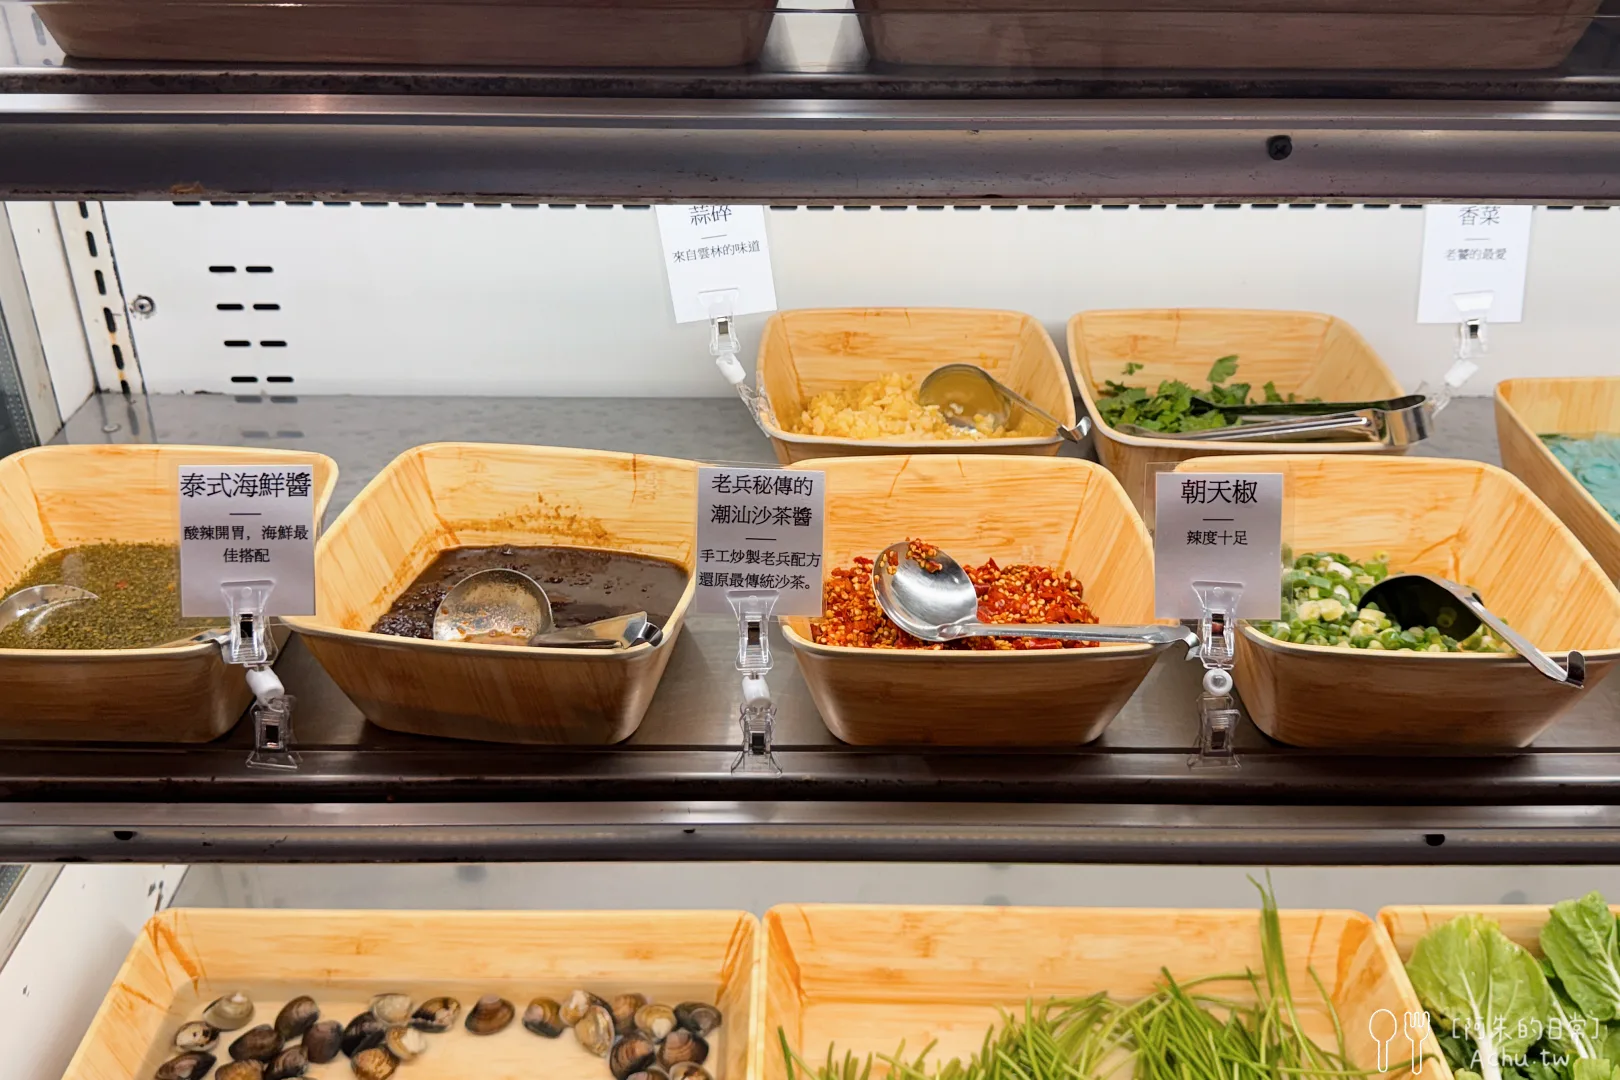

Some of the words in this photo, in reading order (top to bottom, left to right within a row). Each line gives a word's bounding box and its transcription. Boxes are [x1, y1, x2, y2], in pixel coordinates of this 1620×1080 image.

[1459, 205, 1501, 226] 香菜
[673, 239, 761, 263] 來自雲林的味道
[180, 472, 312, 498] 泰式海鮮醬
[711, 473, 814, 496] 老兵秘傳的
[1180, 479, 1258, 505] 朝天椒
[710, 504, 813, 527] 潮汕沙茶醬
[1186, 529, 1249, 546] 辣度十足
[223, 547, 271, 563] 佳搭配
[699, 548, 822, 568] 手工炒製老兵配方
[698, 571, 811, 591] 還原最傳統沙茶。
